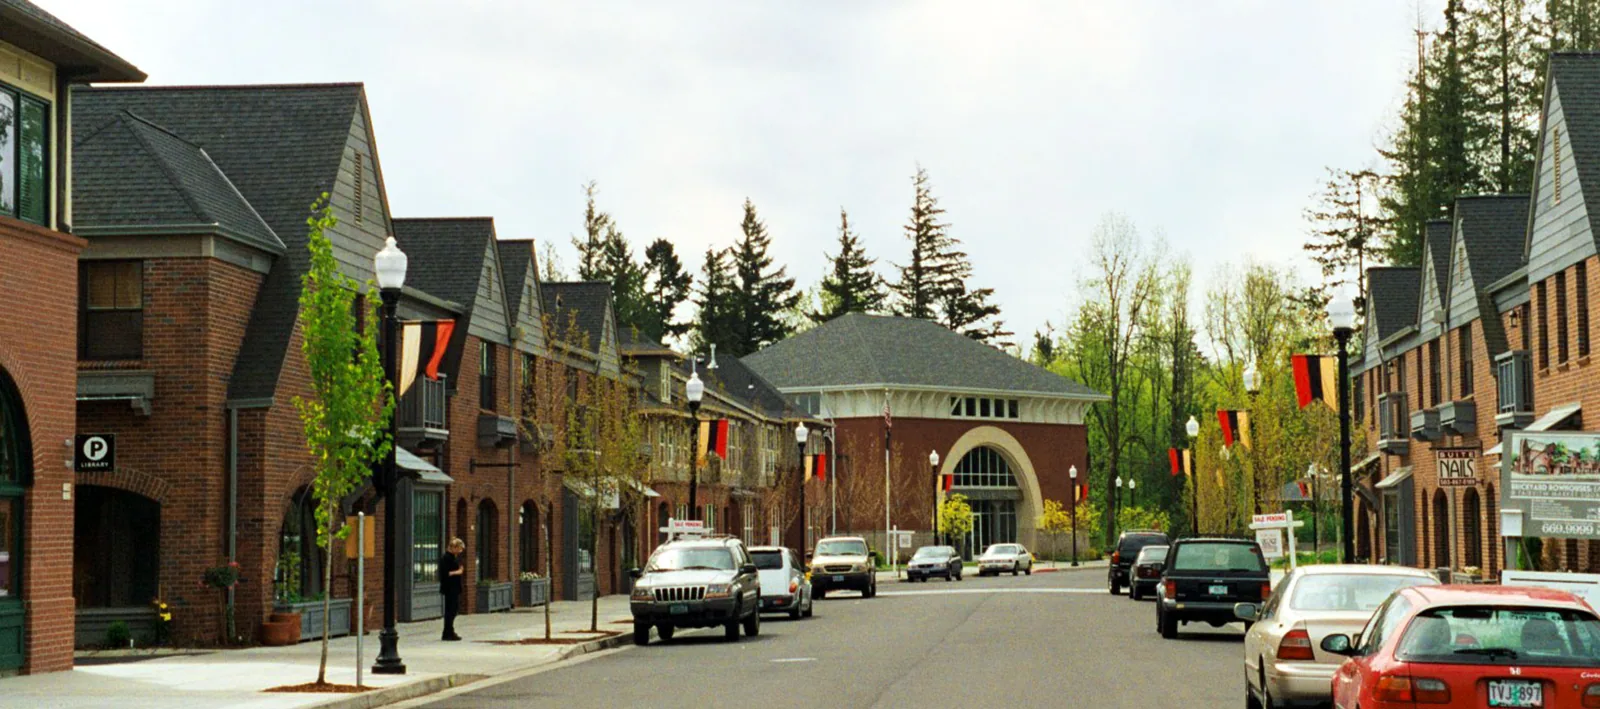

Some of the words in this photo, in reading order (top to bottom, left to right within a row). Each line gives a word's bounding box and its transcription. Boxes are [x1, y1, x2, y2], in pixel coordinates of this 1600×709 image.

[90, 440, 104, 457] P
[1440, 458, 1474, 477] NAILS
[1490, 685, 1512, 700] TVJ
[1519, 685, 1541, 701] 897
